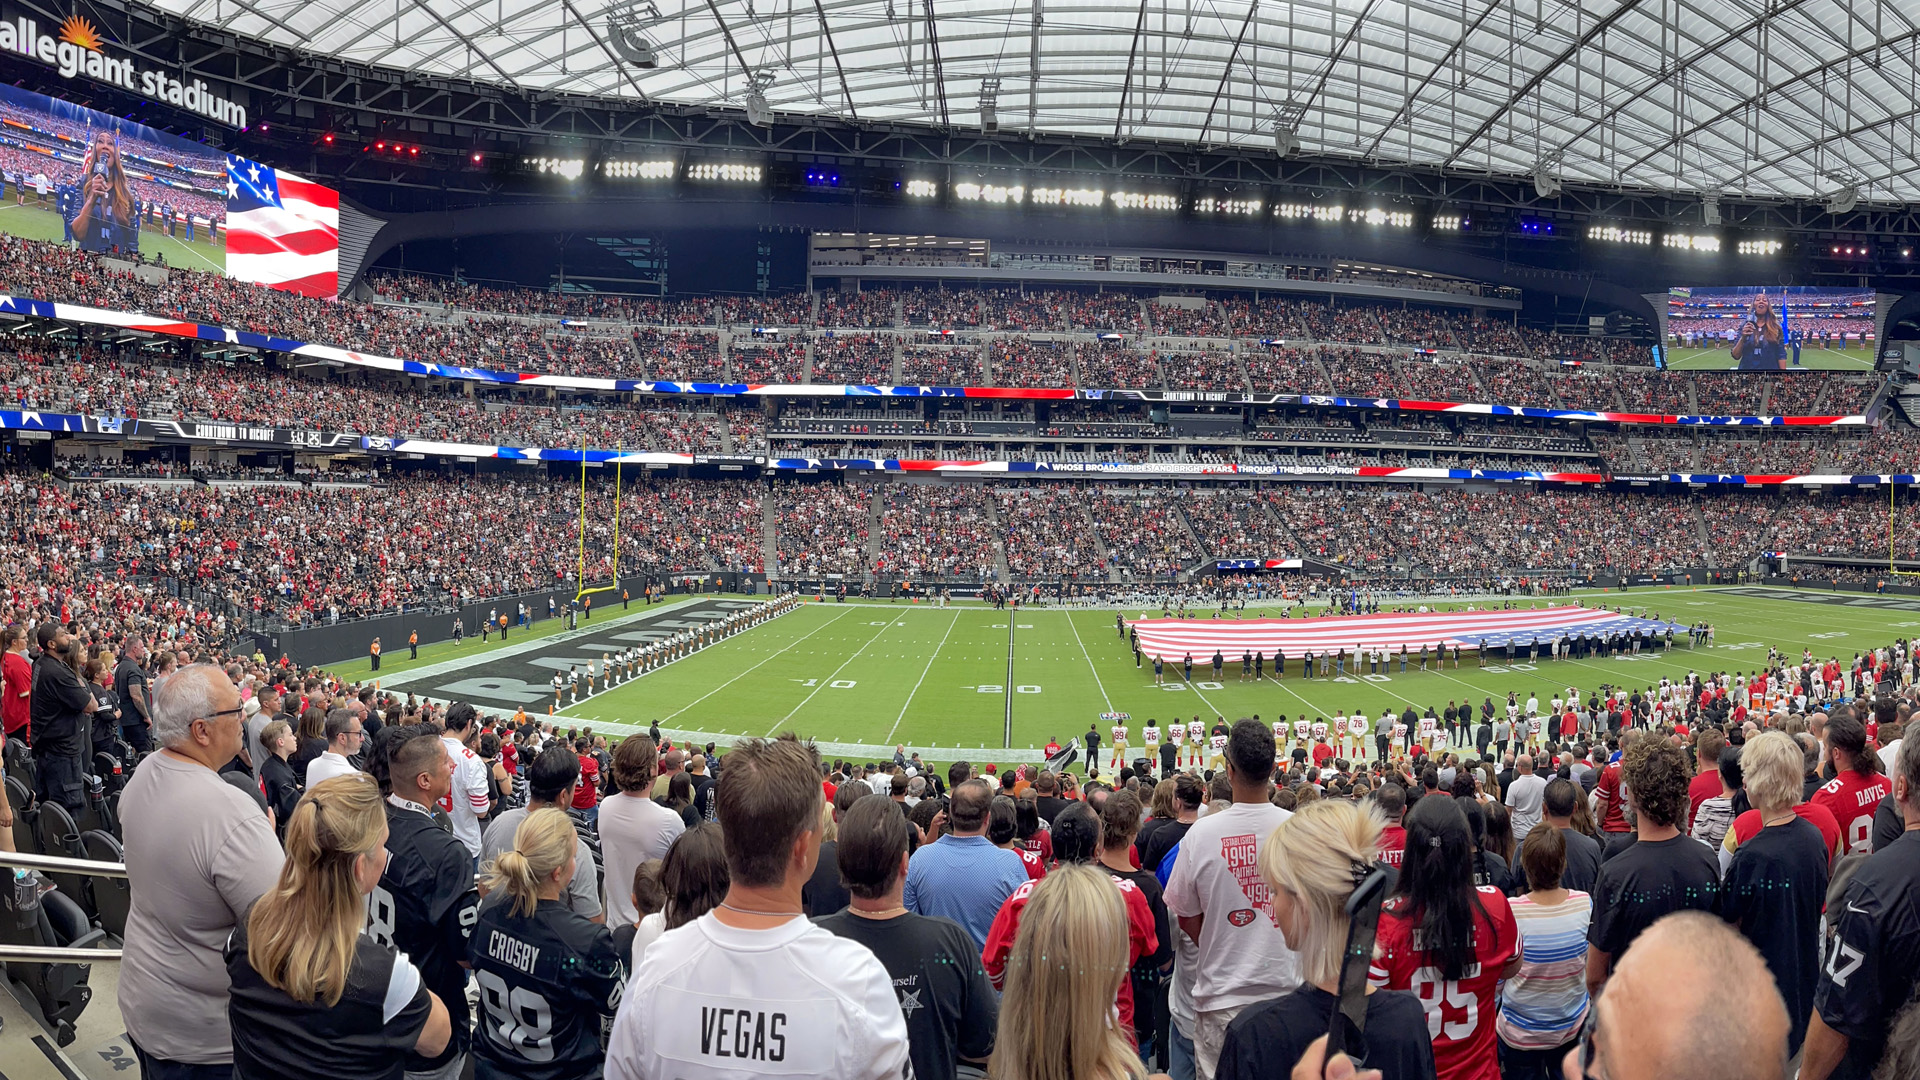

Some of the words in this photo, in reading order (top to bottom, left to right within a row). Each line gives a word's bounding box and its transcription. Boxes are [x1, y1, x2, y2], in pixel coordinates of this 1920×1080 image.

[0, 16, 135, 90] allegiant
[141, 70, 247, 128] stadium
[195, 424, 236, 439] COUNTDOWN
[238, 427, 247, 440] TO
[249, 427, 275, 441] KICKOFF
[1051, 463, 1084, 472] WHOSE
[1085, 463, 1115, 472] BROAD
[1115, 463, 1152, 472] STRIPES
[1154, 464, 1173, 473] AND
[1174, 464, 1206, 473] BRIGHT
[1237, 464, 1277, 474] THROUGH
[1278, 466, 1295, 474] THE
[1296, 466, 1336, 475] PERILOUS
[1337, 466, 1361, 475] FIGHT
[977, 684, 1042, 694] 20
[1160, 681, 1225, 691] 30
[1299, 725, 1307, 734] 61
[1353, 719, 1363, 728] 78
[1423, 722, 1433, 731] 77
[1114, 731, 1124, 740] 89
[1146, 731, 1157, 741] 76
[1171, 728, 1182, 738] 66
[1192, 725, 1202, 735] 63
[1315, 726, 1325, 736] 67
[1215, 738, 1225, 749] 55
[1855, 784, 1886, 807] DAVIS
[1223, 835, 1255, 847] ESTABLISHED
[1224, 844, 1256, 868] 1946
[1232, 866, 1259, 880] FAITHFU
[488, 929, 541, 975] CROSBY
[1826, 931, 1866, 988] 17
[891, 974, 918, 987] urself
[81, 990, 89, 1002] 24
[1410, 961, 1482, 1041] 85
[476, 968, 555, 1062] 98
[701, 1006, 787, 1063] VEGAS
[97, 1045, 136, 1072] 24
